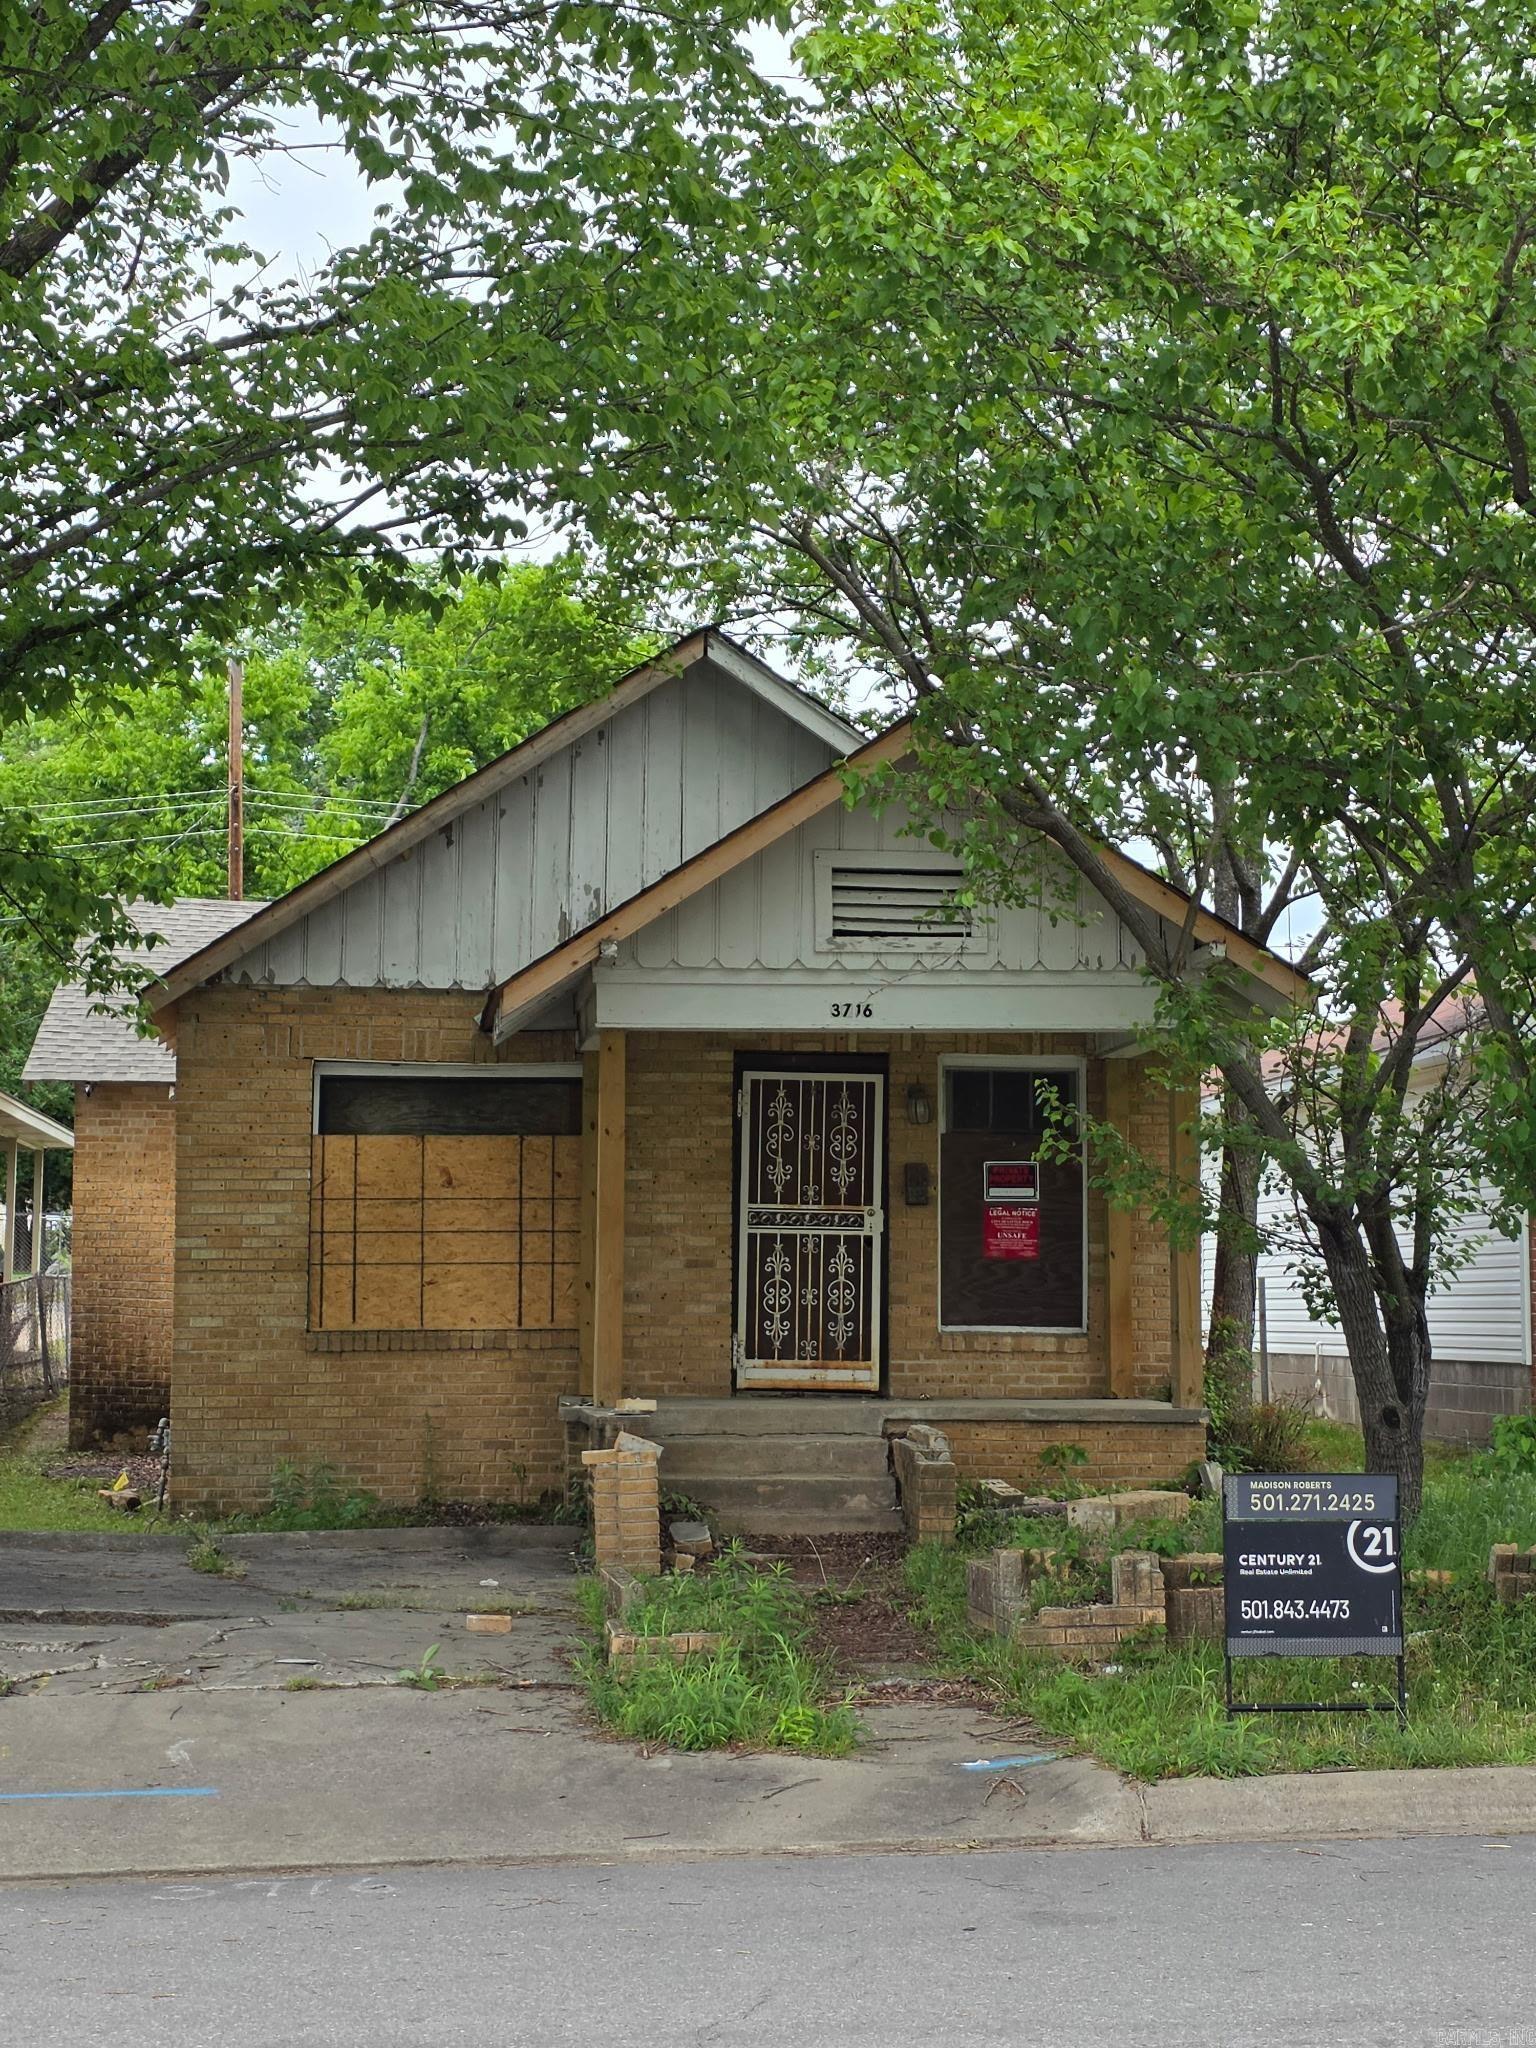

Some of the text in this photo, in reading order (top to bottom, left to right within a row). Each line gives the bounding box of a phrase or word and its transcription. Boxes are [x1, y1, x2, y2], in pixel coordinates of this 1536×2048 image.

[831, 1003, 873, 1018] 3716
[989, 1175, 1035, 1184] PROPERTY
[1250, 1481, 1332, 1489] MADISON ROBERTS
[1250, 1494, 1375, 1511] 501.271.2425
[1239, 1554, 1305, 1566] CENTURY
[1241, 1600, 1350, 1619] 501.843.4473
